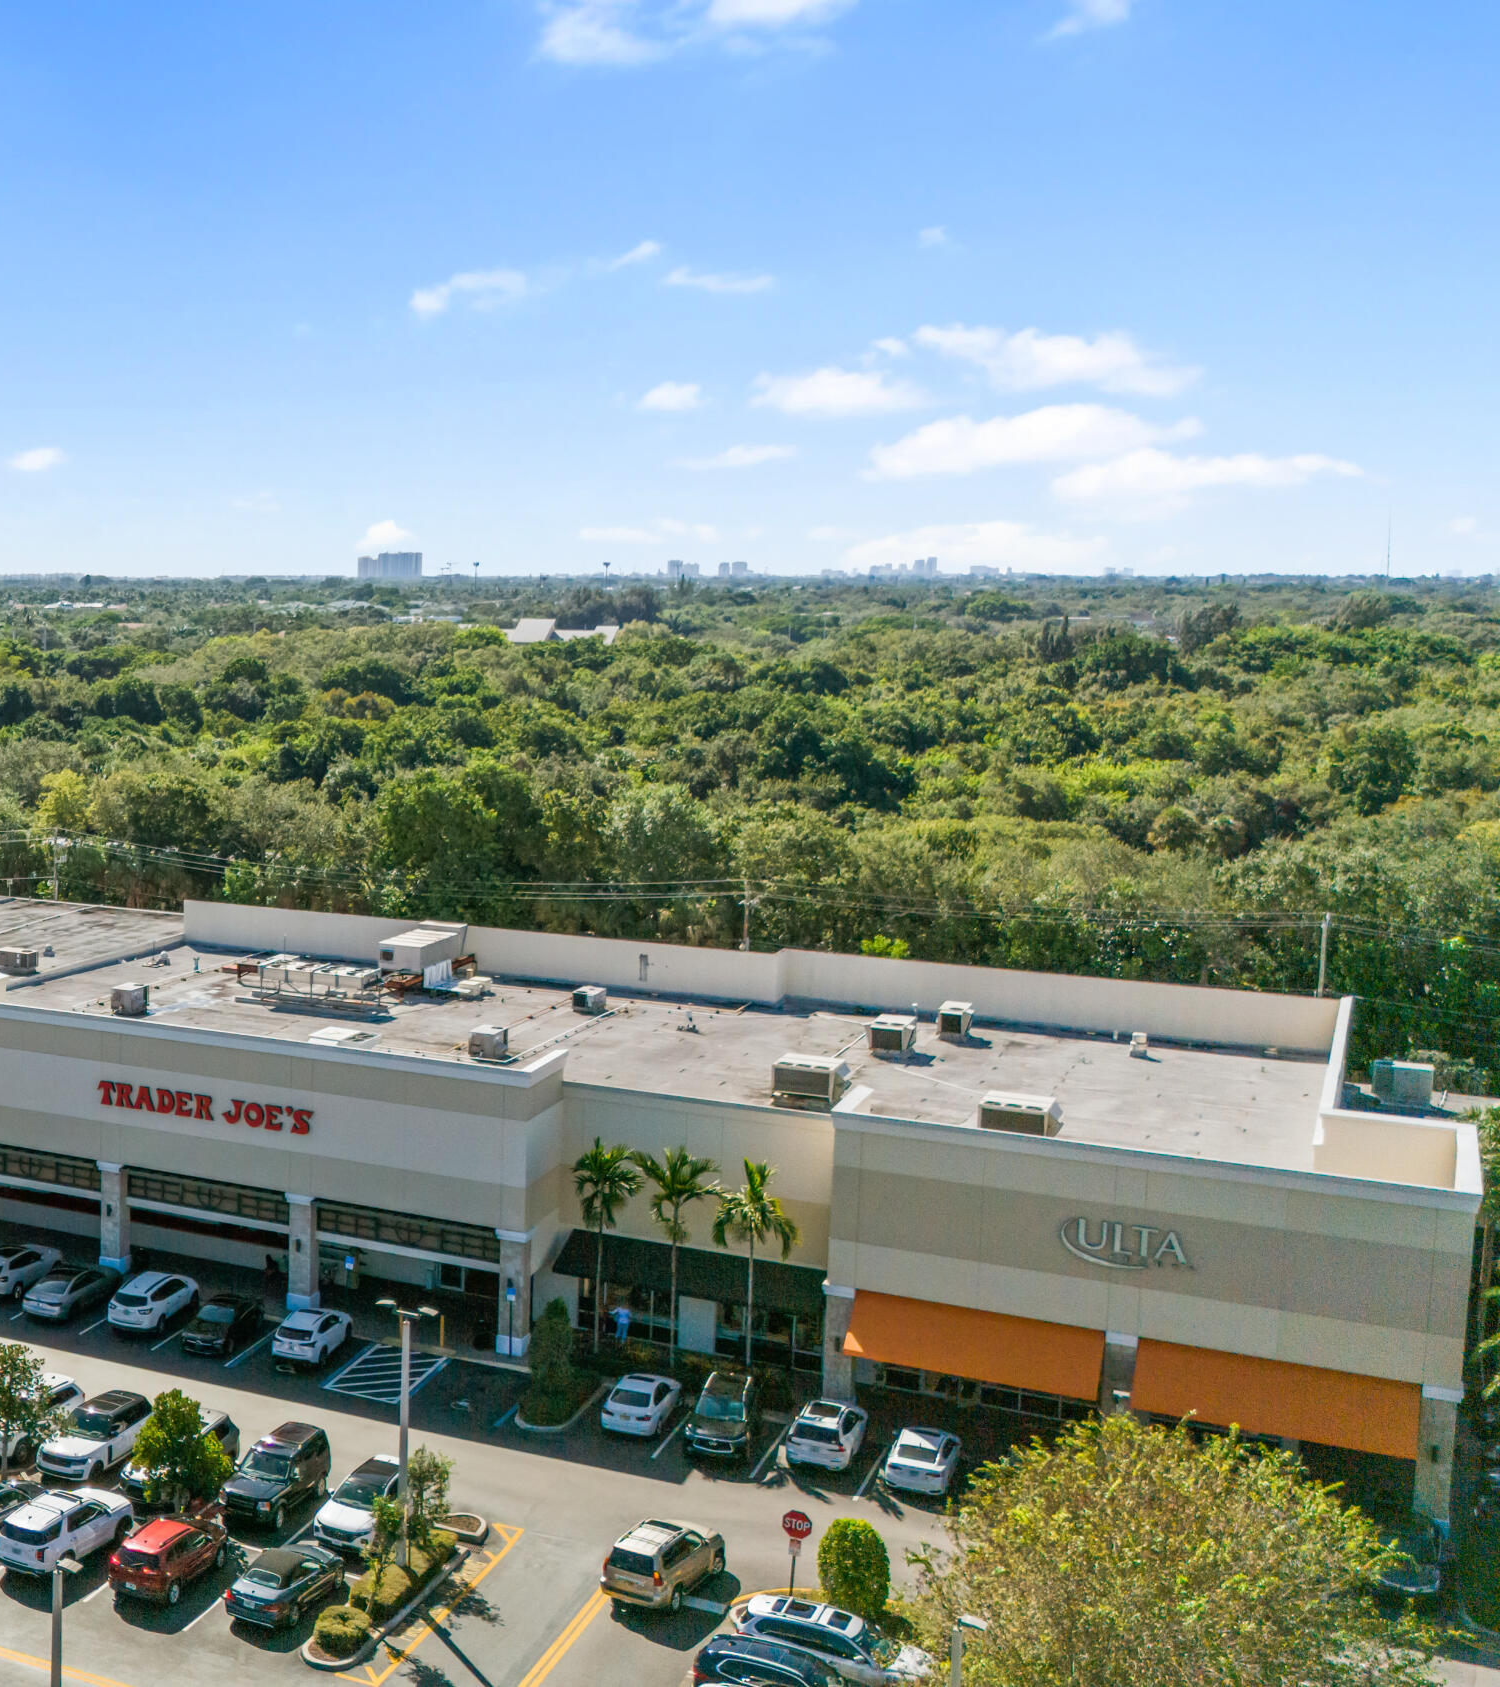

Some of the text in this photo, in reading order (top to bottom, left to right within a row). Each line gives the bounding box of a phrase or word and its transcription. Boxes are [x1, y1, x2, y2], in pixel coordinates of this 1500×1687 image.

[97, 1080, 314, 1135] TRADER JOE'S
[1077, 1217, 1187, 1265] ULTA
[783, 1517, 811, 1532] STOP
